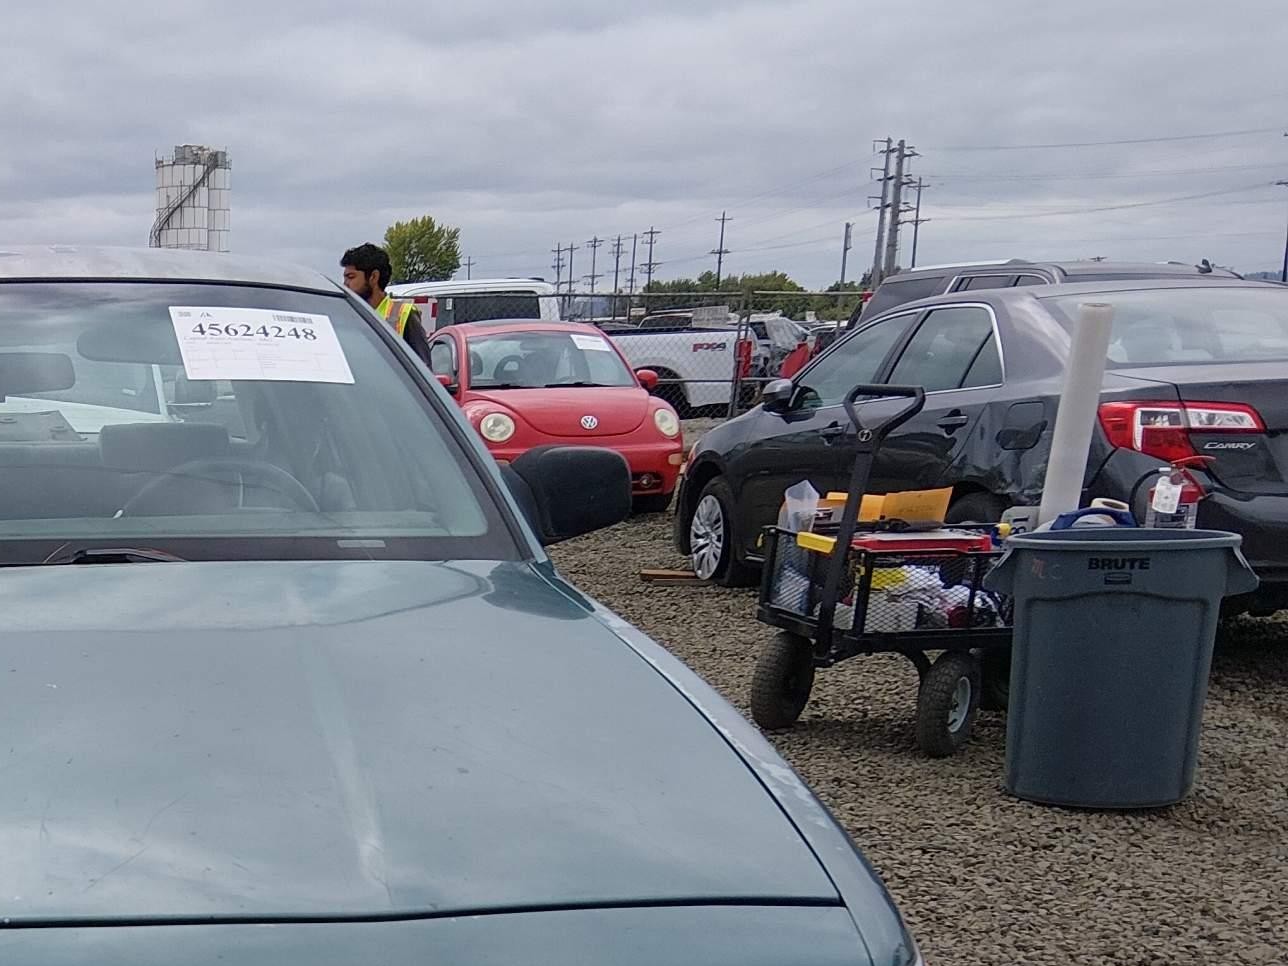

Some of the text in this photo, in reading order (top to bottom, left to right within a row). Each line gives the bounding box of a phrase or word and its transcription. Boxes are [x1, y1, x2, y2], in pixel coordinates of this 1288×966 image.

[191, 322, 318, 341] 45624248
[1203, 441, 1257, 450] CAMRY
[1087, 557, 1151, 571] BRUTE
